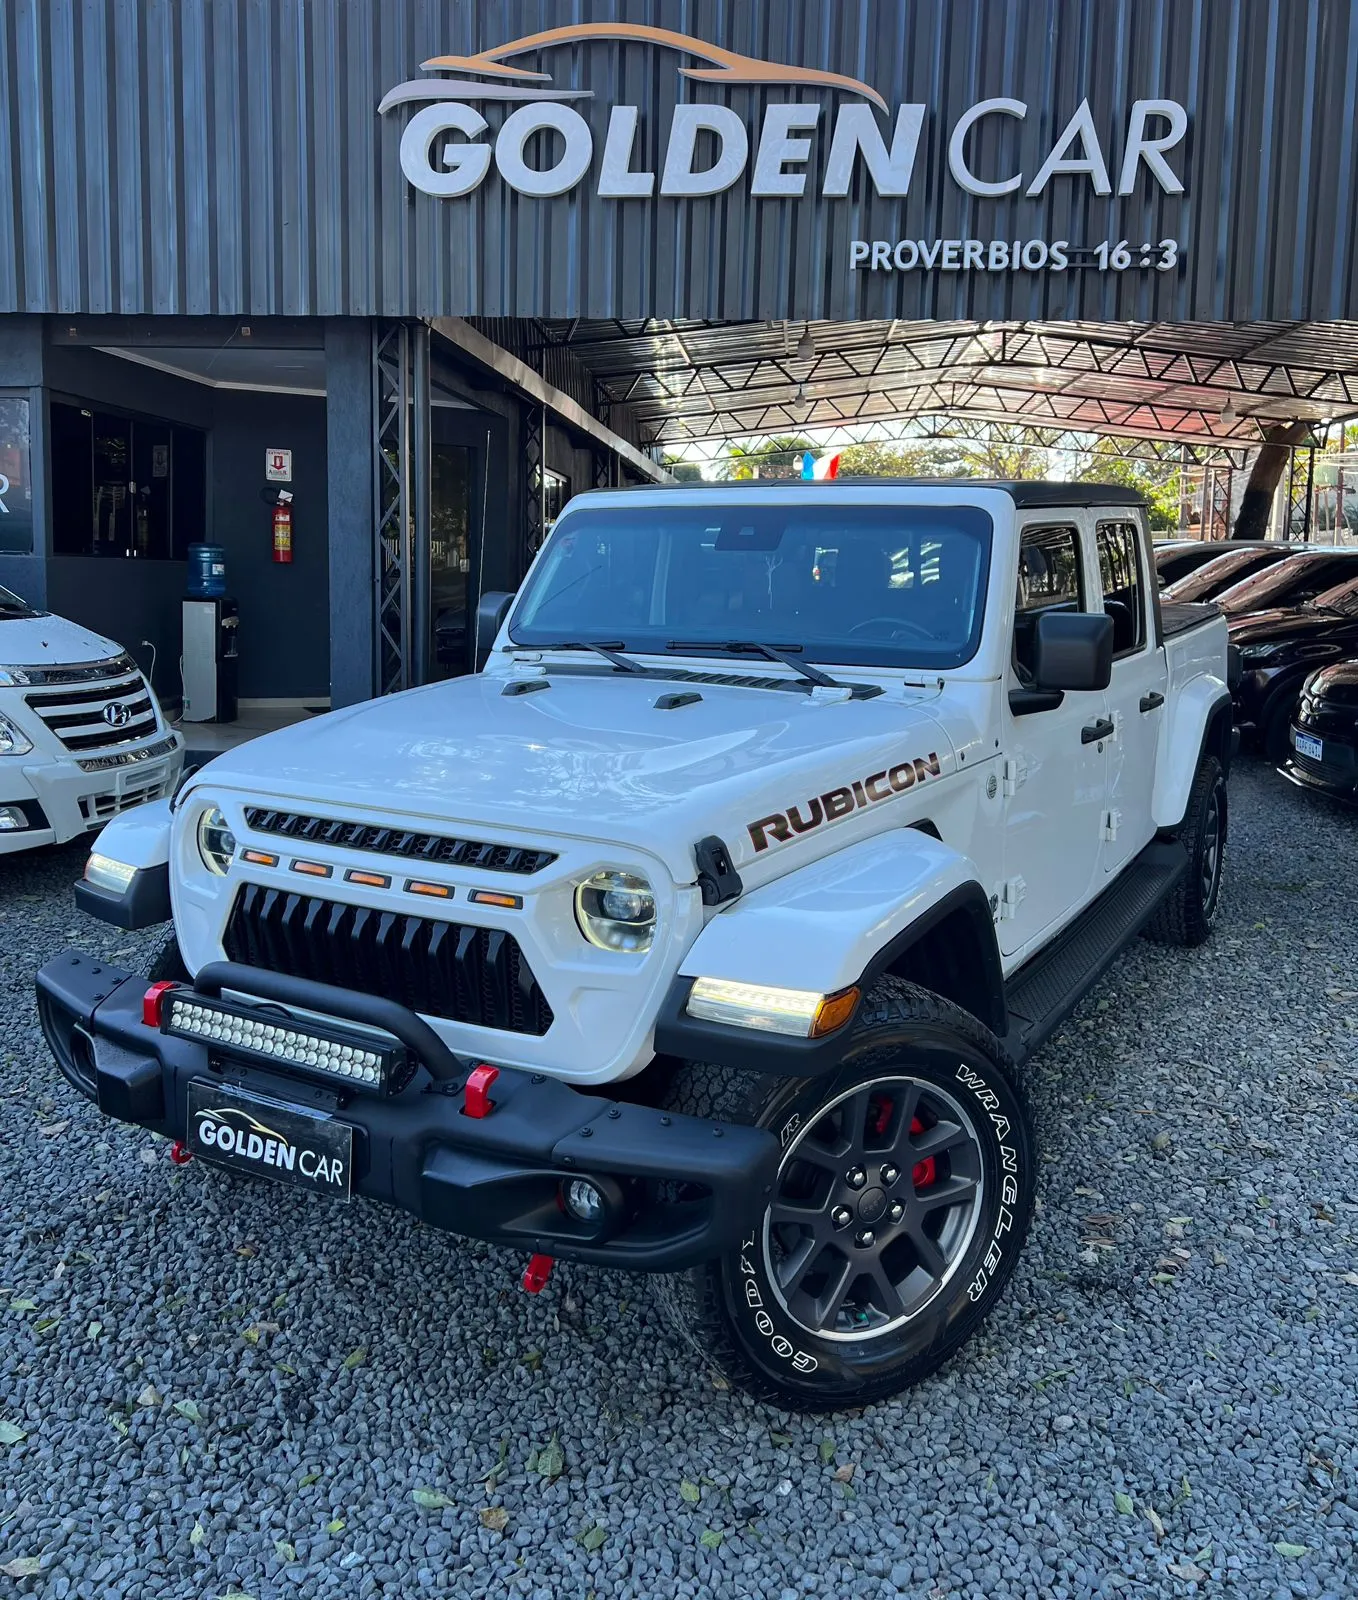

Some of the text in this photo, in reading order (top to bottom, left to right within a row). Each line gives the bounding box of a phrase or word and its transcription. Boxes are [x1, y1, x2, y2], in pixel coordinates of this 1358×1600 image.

[400, 97, 1188, 198] GOLDEN CAR
[850, 238, 1069, 271] PROVERBIOS
[746, 751, 941, 853] RUBICON
[199, 1119, 344, 1186] GOLDEN CAR
[955, 1063, 1018, 1302] WRANGLER
